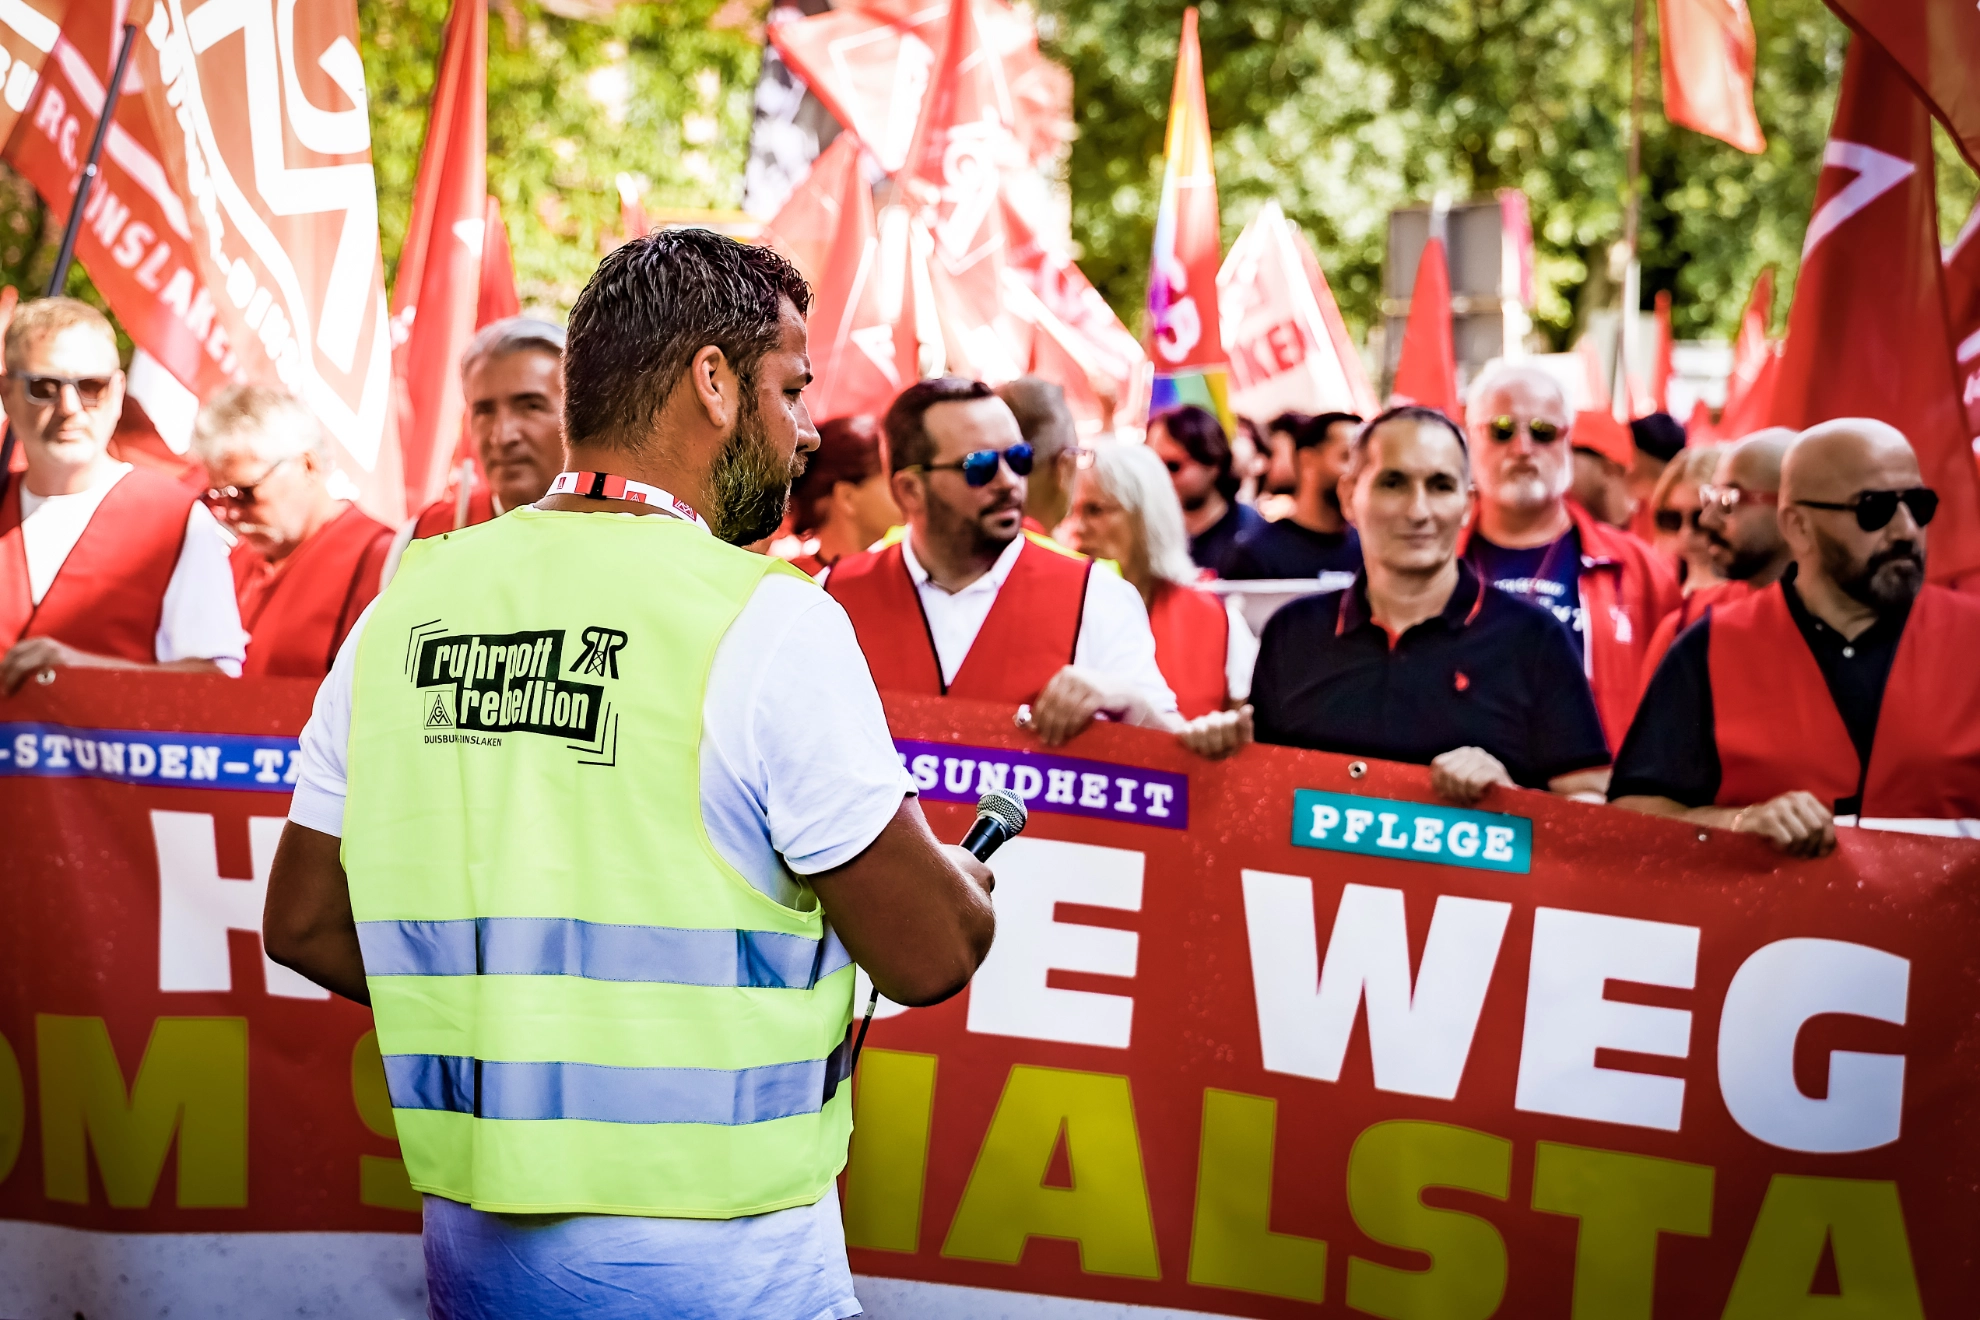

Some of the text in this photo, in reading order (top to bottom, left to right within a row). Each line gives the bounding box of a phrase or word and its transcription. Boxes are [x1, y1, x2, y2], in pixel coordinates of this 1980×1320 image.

[432, 636, 554, 689] ruhrpott
[459, 680, 590, 730] rebellion
[897, 752, 1174, 818] SUNDHEIT
[1309, 803, 1515, 862] PFLEGE
[1240, 868, 1911, 1154] WEG
